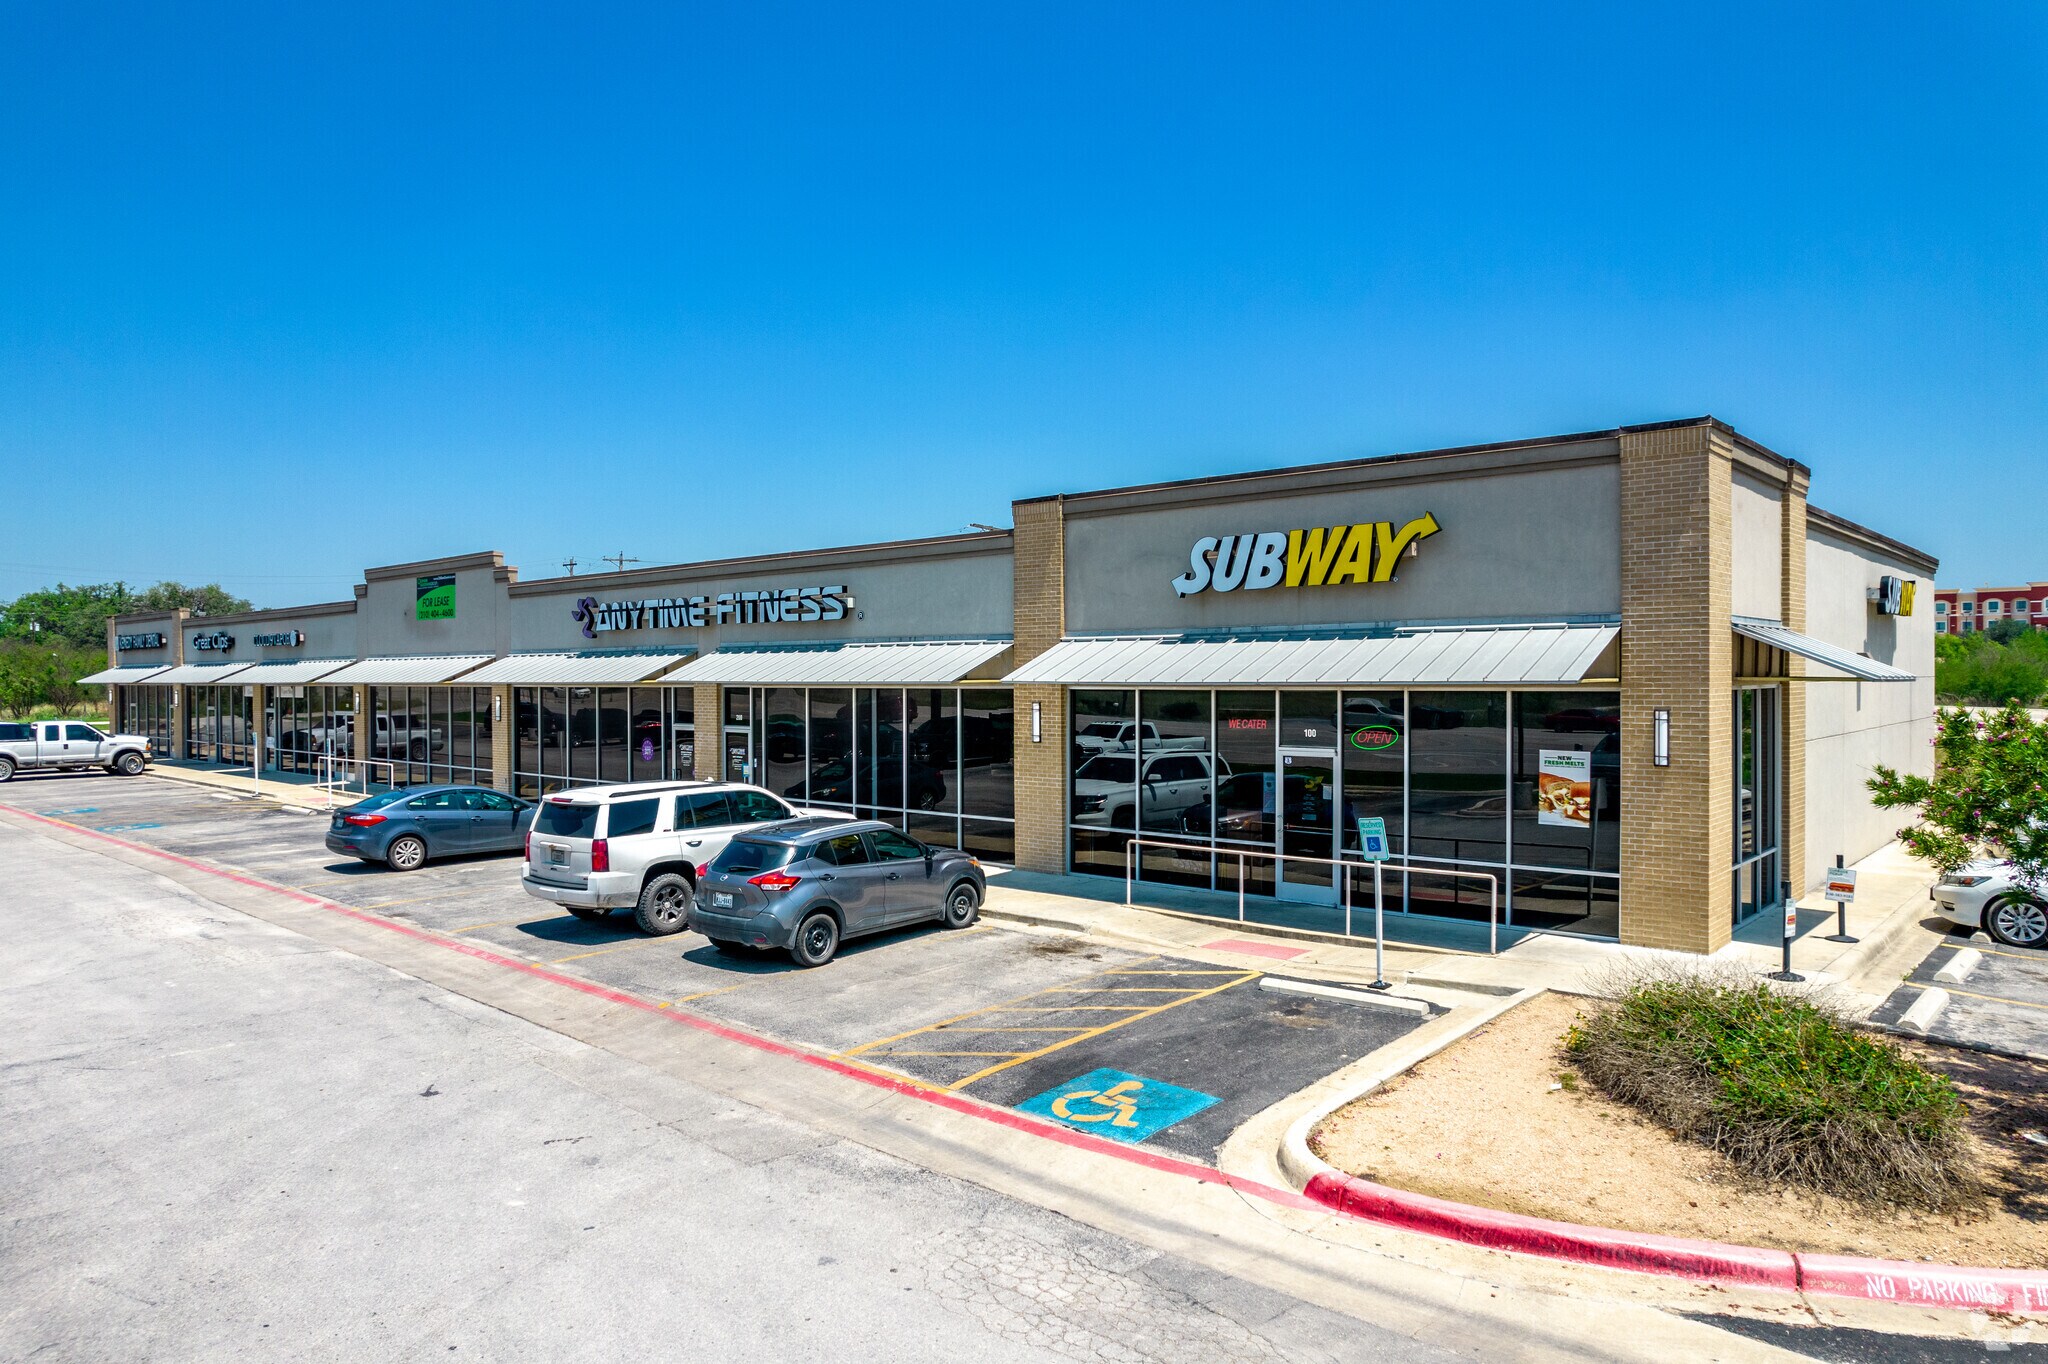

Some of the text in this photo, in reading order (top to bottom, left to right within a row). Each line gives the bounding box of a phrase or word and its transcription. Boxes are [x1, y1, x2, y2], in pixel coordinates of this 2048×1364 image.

[1171, 511, 1441, 598] SUBWAY
[422, 595, 450, 608] FOR LEASE
[1884, 576, 1916, 616] SUBWAY
[596, 585, 847, 631] ANYTIME FITNESS
[193, 632, 229, 651] Great Clips
[1228, 719, 1267, 729] WE CATER
[1304, 729, 1317, 738] 100
[1357, 731, 1392, 744] OPEN
[1866, 1275, 1896, 1299] NO
[1907, 1276, 2000, 1305] PARKING
